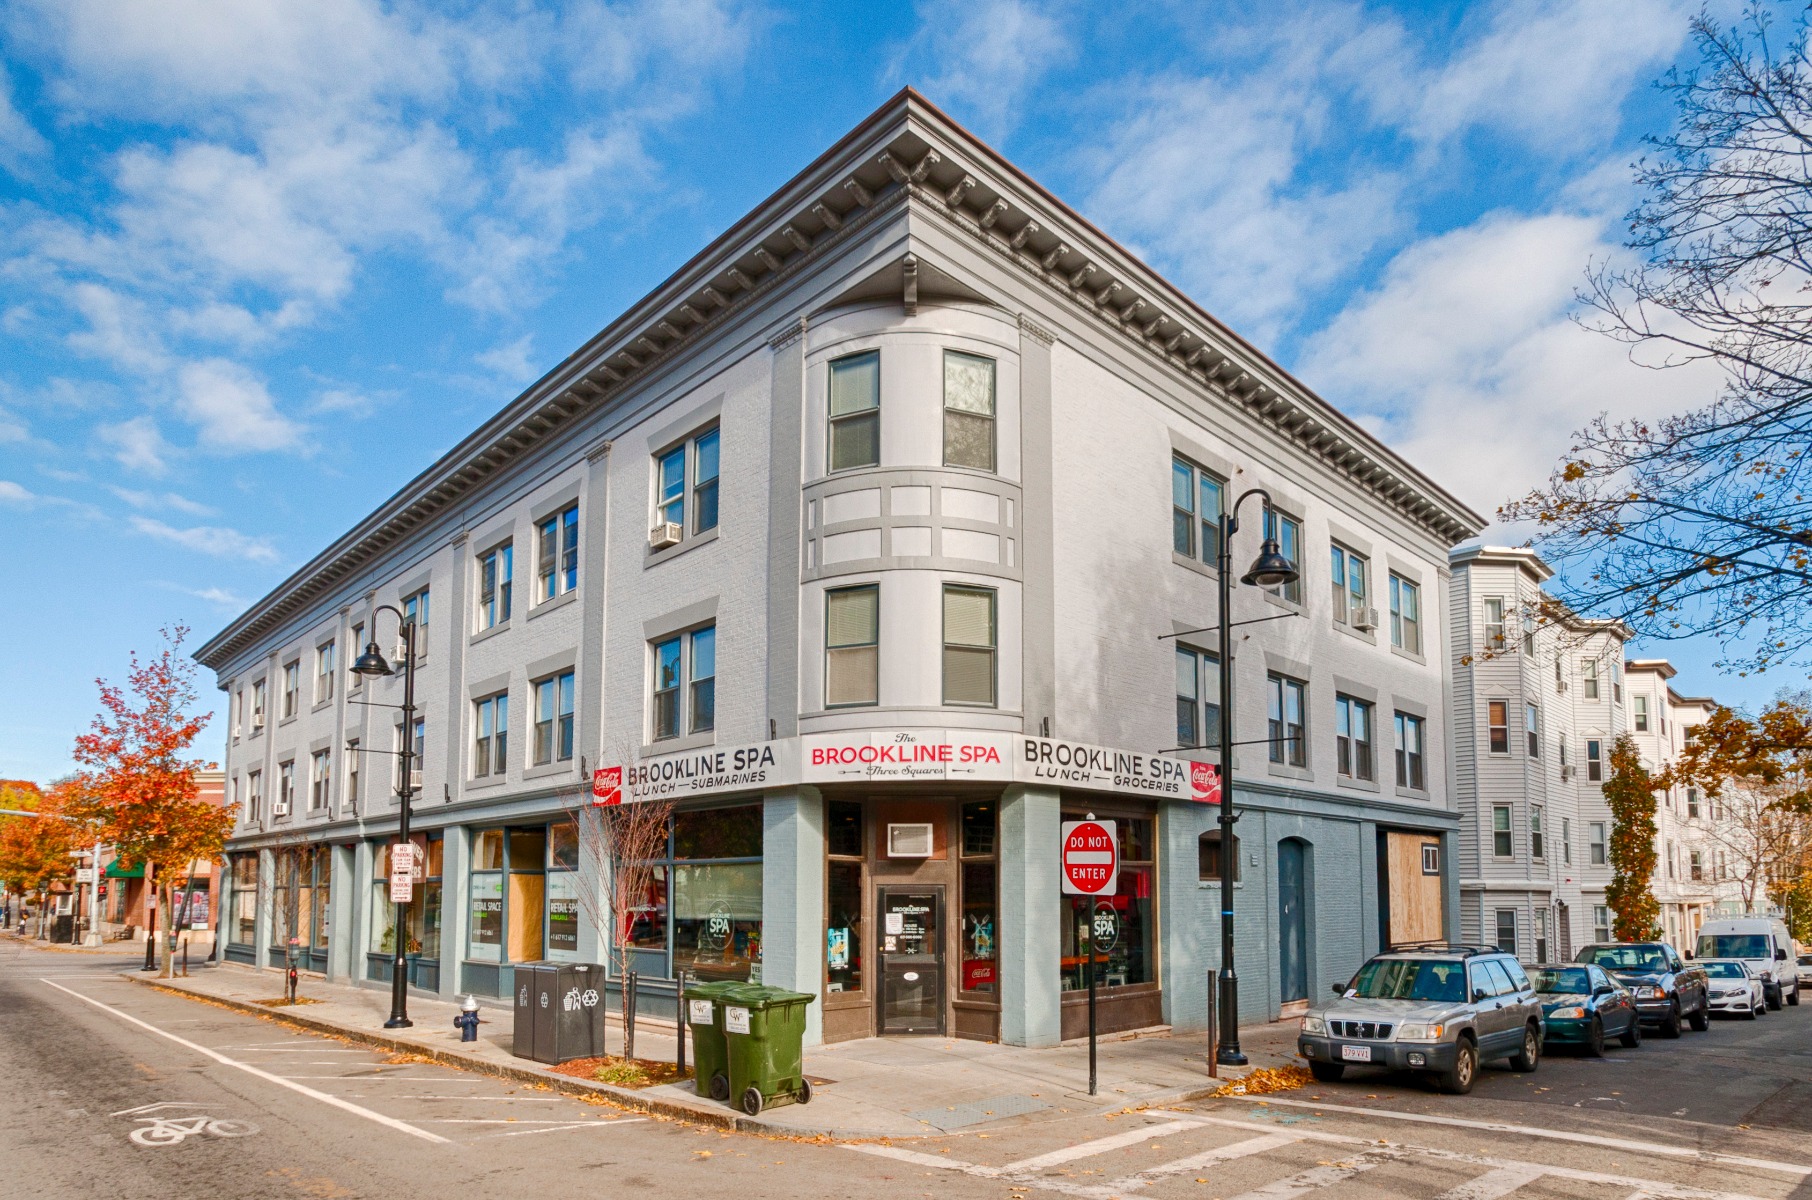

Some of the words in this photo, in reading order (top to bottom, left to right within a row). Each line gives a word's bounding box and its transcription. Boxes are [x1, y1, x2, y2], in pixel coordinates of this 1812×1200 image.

[895, 733, 916, 743] The
[812, 745, 953, 765] BROOKLINE
[959, 745, 1001, 764] SPA
[1024, 739, 1143, 776] BROOKLINE
[1150, 758, 1186, 782] SPA
[628, 752, 726, 786] BROOKLINE
[734, 745, 775, 771] SPA
[866, 766, 899, 776] Three
[901, 765, 945, 778] Squares
[634, 782, 676, 797] LUNCH
[691, 770, 766, 790] SUBMARINES
[1034, 766, 1091, 782] LUNCH
[1114, 775, 1179, 793] GROCERIES
[1070, 836, 1084, 848] DO
[1088, 836, 1107, 848] NOT
[1072, 867, 1106, 879] ENTER
[473, 901, 487, 911] RETAIL
[488, 902, 502, 912] SPACE
[550, 902, 567, 913] RETAIL
[709, 918, 730, 933] SPA
[1094, 920, 1115, 936] SPA
[1344, 1049, 1356, 1057] 379
